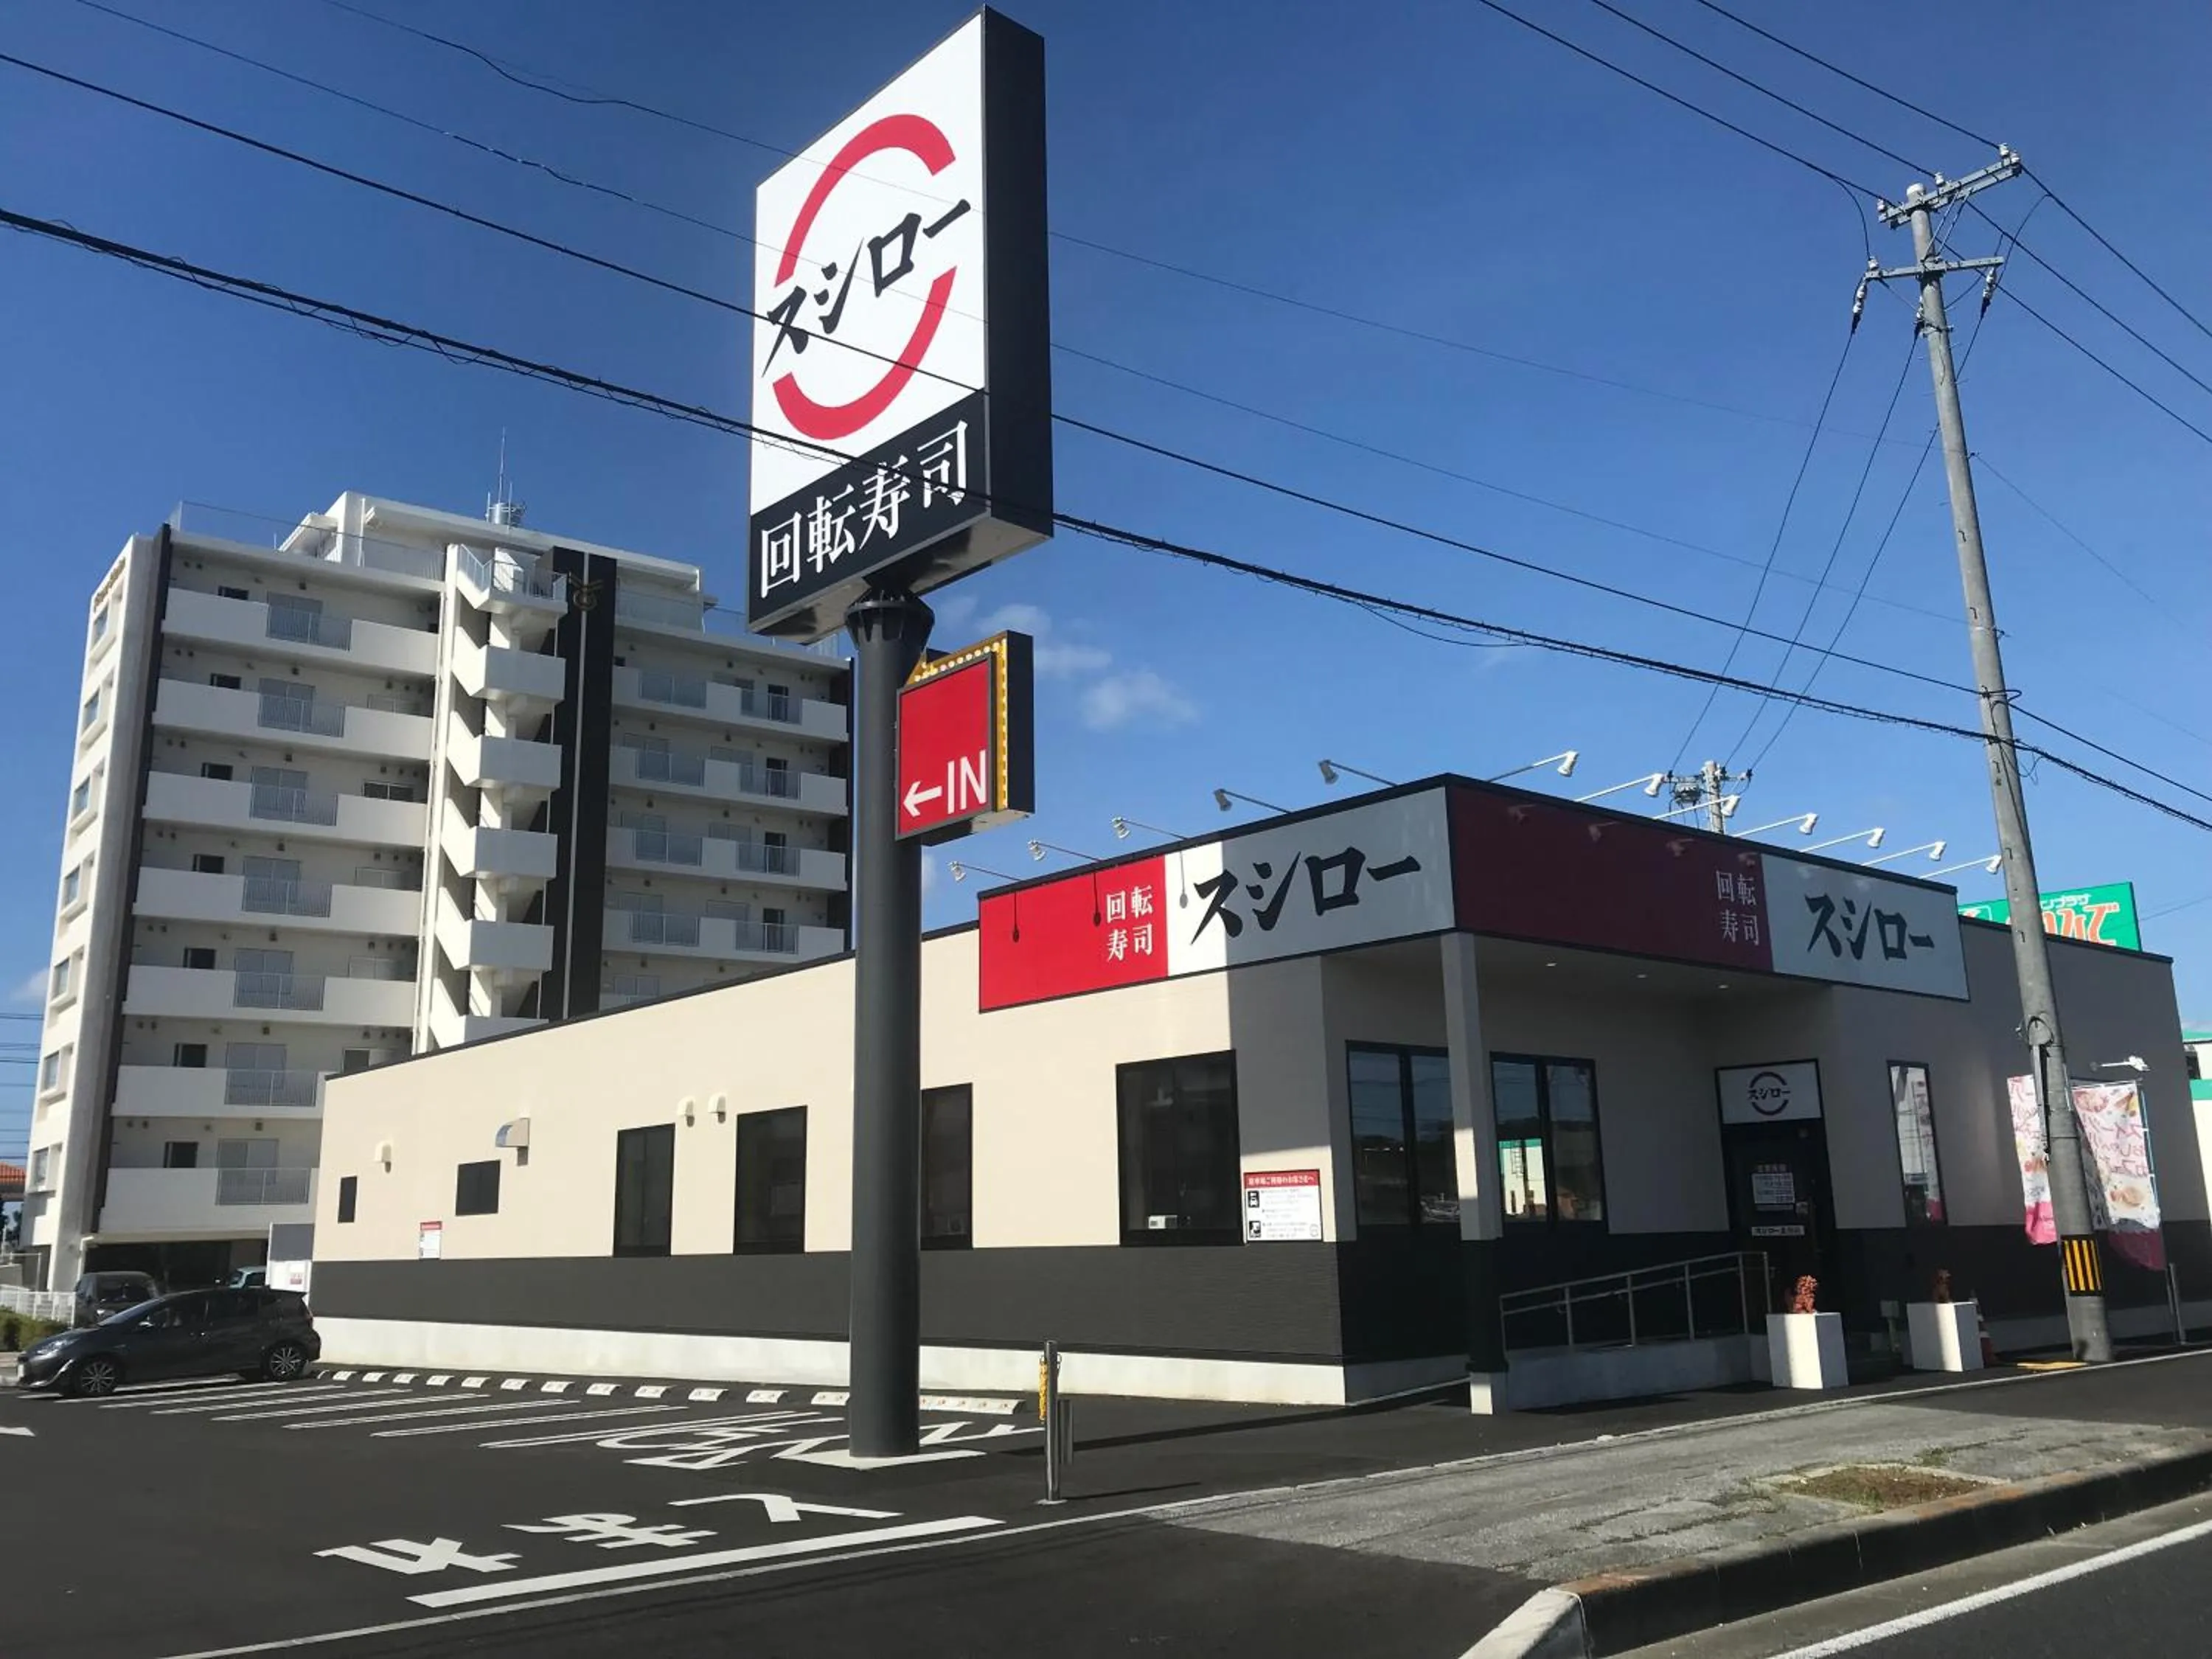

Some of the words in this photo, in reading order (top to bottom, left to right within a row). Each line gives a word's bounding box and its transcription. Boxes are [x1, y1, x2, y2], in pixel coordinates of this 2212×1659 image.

[762, 199, 971, 378] スシロー
[760, 420, 968, 599] 回転寿司
[947, 749, 987, 814] IN
[1106, 884, 1155, 922] 回転
[1191, 846, 1421, 945] スシロー
[1715, 870, 1757, 908] 回転
[1107, 923, 1155, 962] 寿司
[1719, 908, 1760, 947] 寿司
[1804, 893, 1935, 960] スシロー
[1747, 1088, 1791, 1101] スシロー
